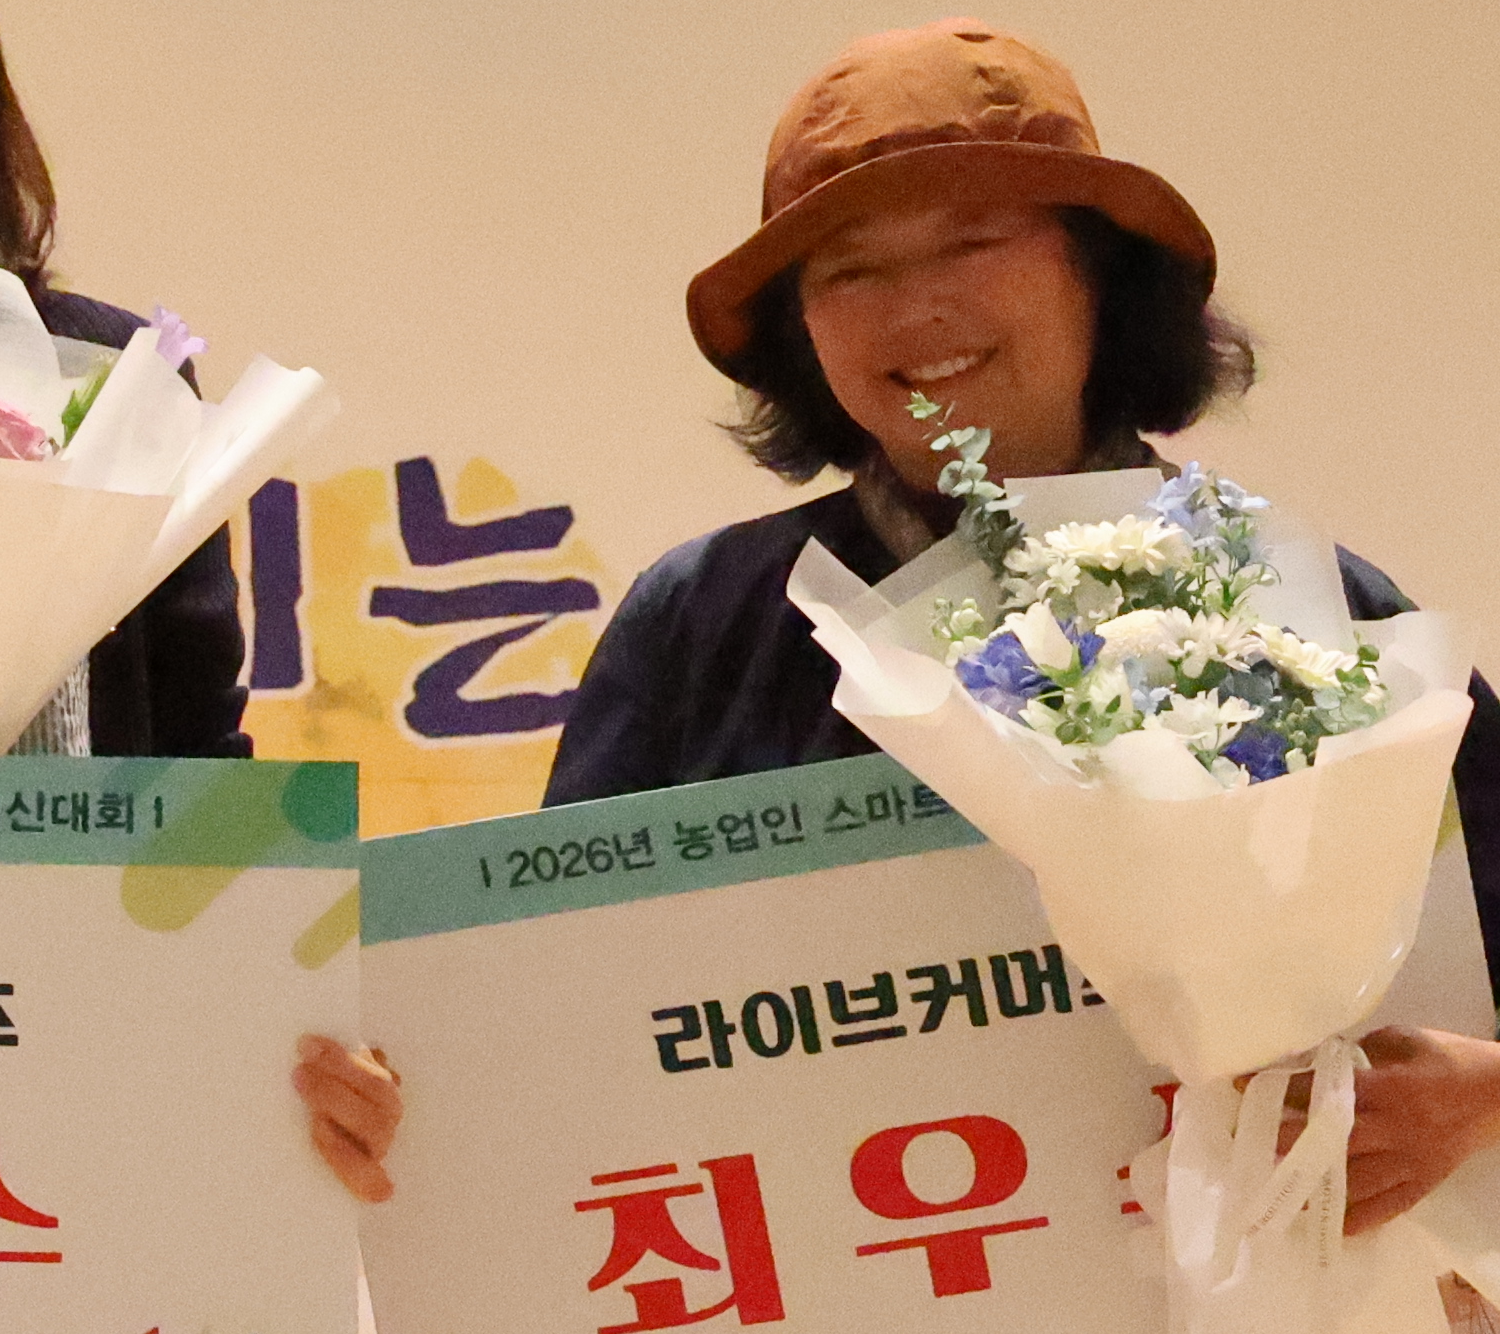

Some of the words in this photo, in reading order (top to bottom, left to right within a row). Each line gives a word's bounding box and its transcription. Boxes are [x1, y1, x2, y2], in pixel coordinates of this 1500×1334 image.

[248, 455, 601, 739] 는
[505, 825, 657, 890] 2026년
[671, 800, 807, 863] 농업인
[823, 782, 955, 834] 스마트
[650, 942, 1107, 1075] 라이브커머
